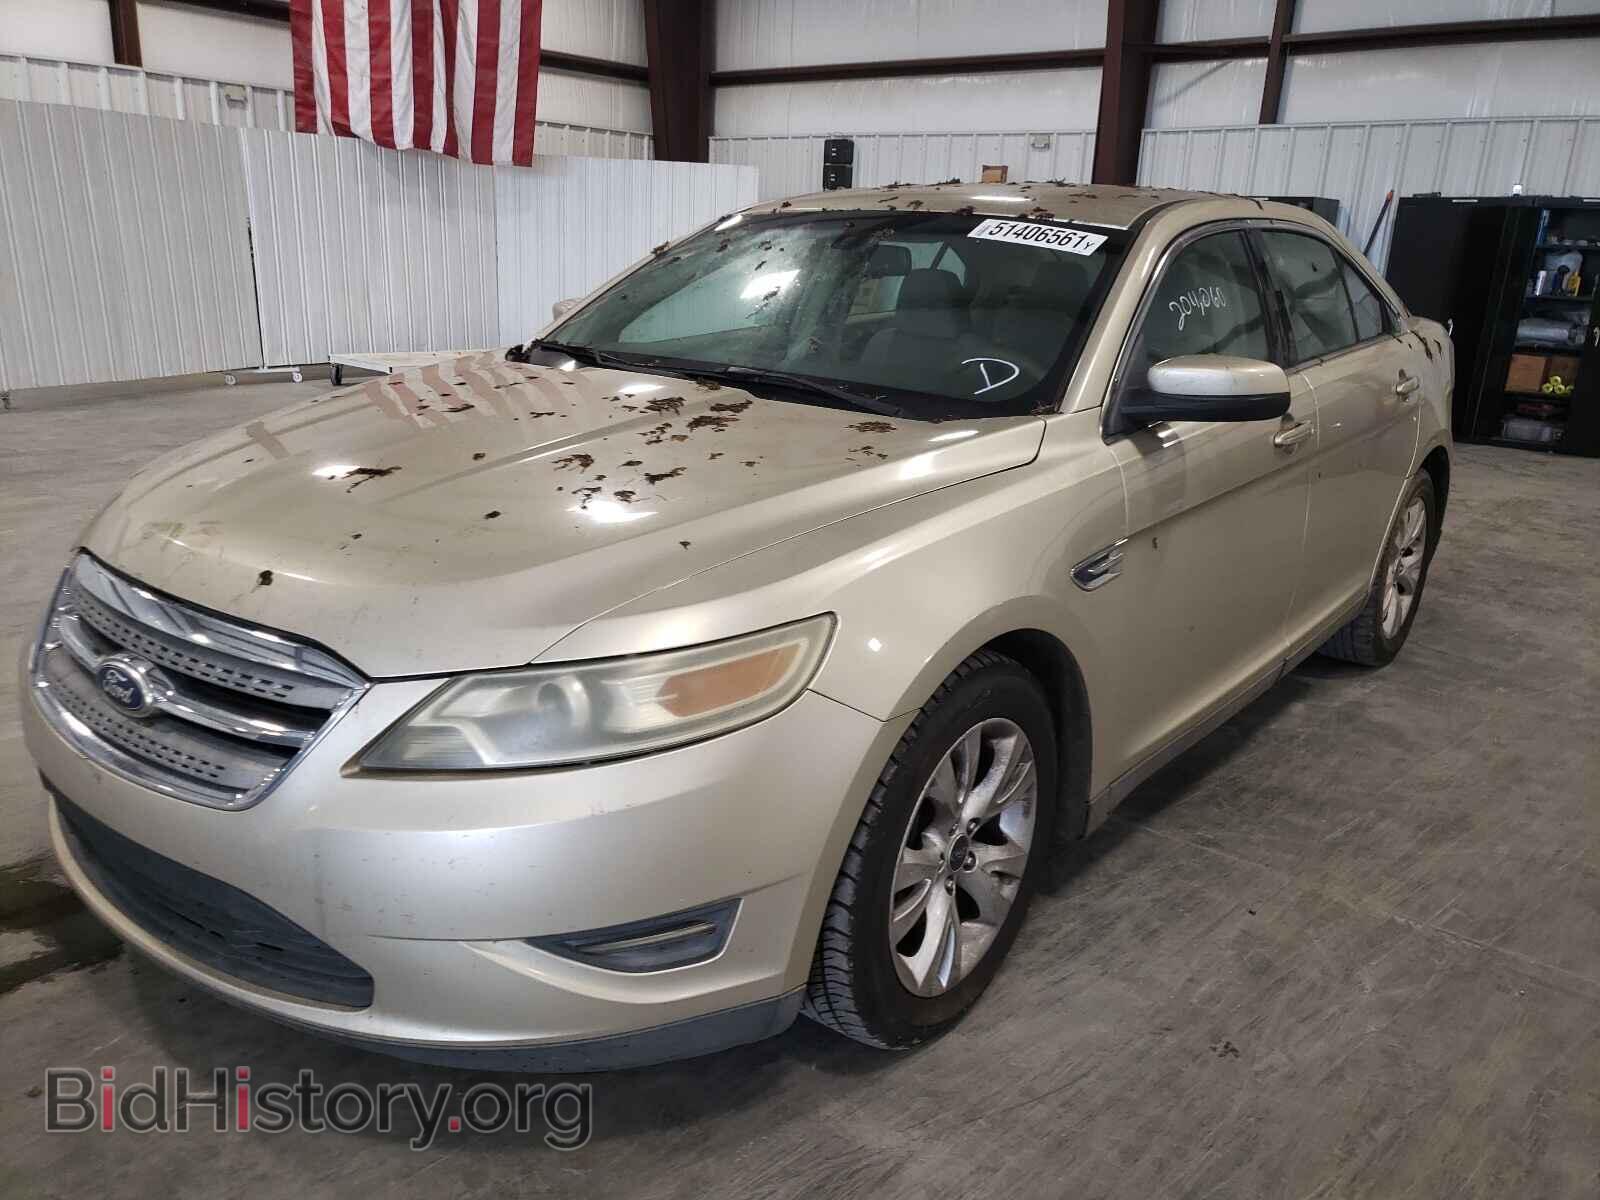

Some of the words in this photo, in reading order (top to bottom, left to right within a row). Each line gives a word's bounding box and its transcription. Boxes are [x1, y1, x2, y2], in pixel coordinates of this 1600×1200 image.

[988, 222, 1089, 249] 51406561
[961, 357, 1020, 395] D
[102, 669, 135, 704] Ford
